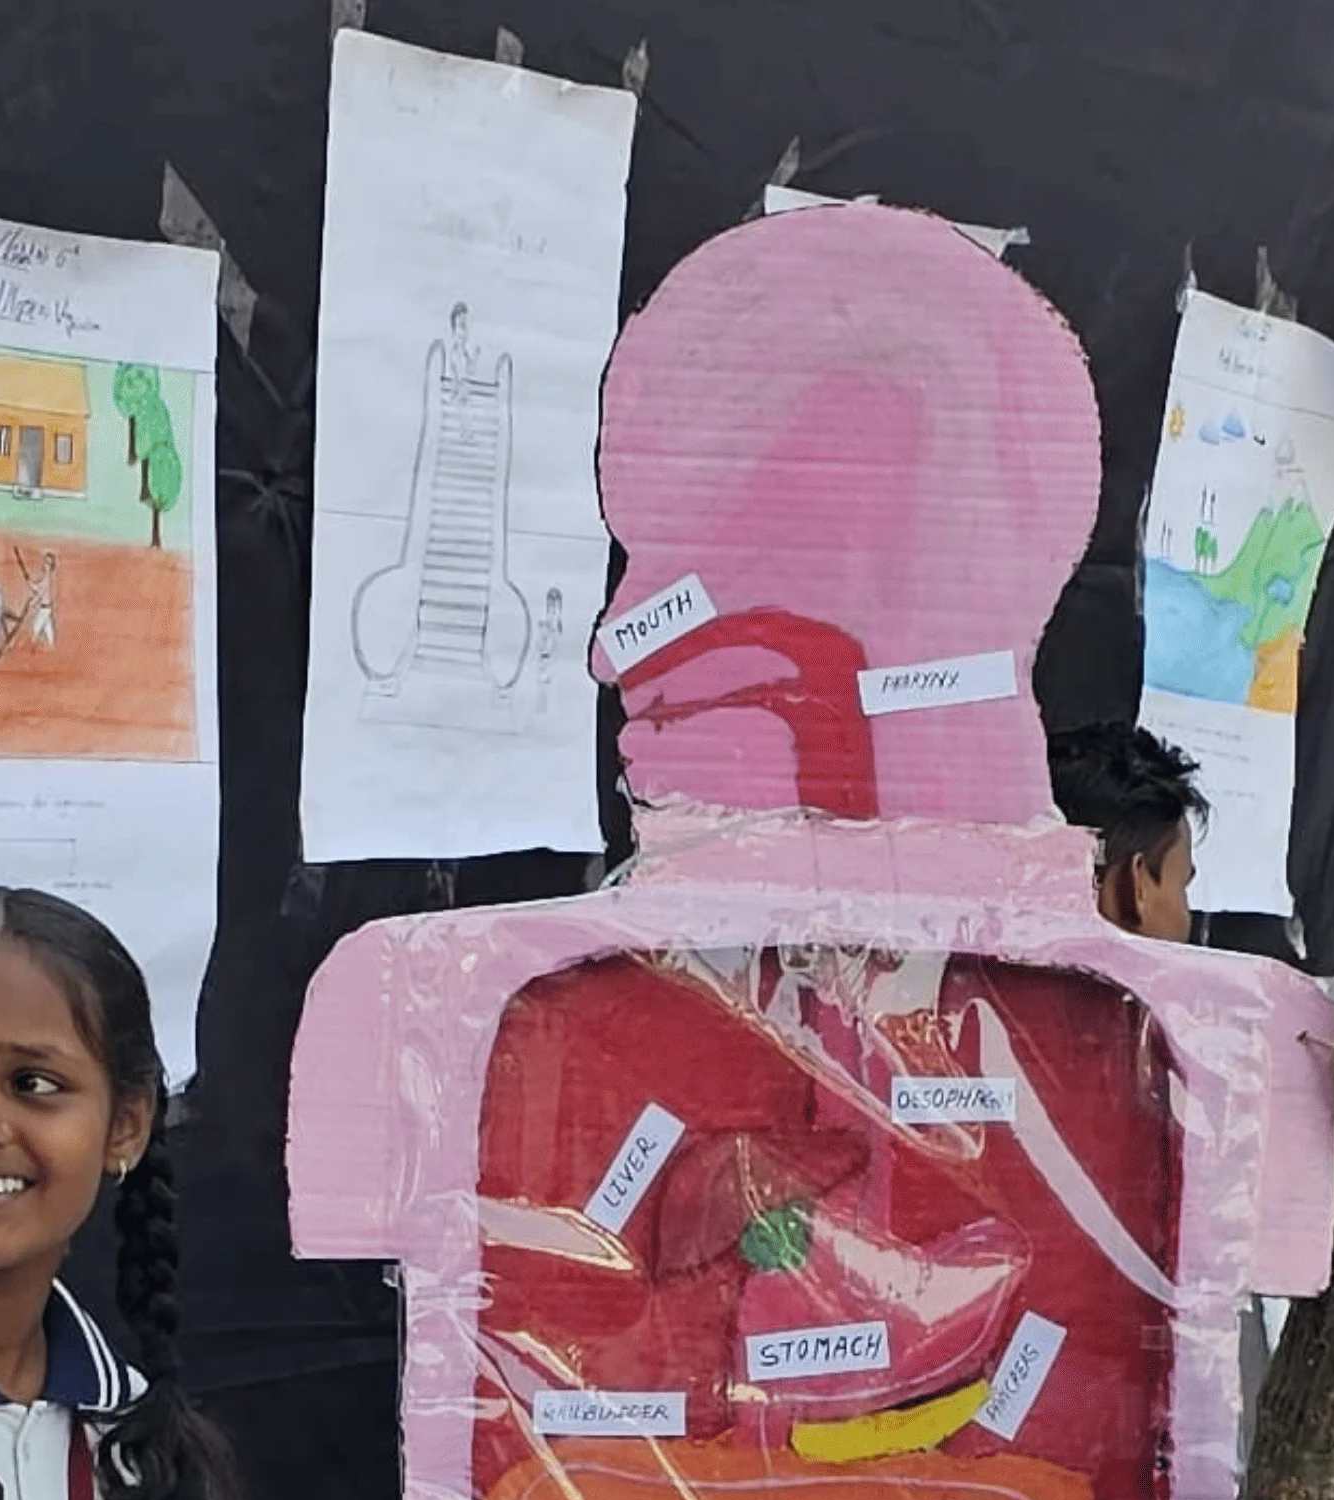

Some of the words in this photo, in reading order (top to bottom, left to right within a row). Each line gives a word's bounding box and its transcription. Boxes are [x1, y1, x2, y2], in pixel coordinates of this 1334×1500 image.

[615, 588, 693, 651] MOUTH
[602, 1136, 659, 1208] LIVER
[759, 1333, 883, 1368] STOMACH
